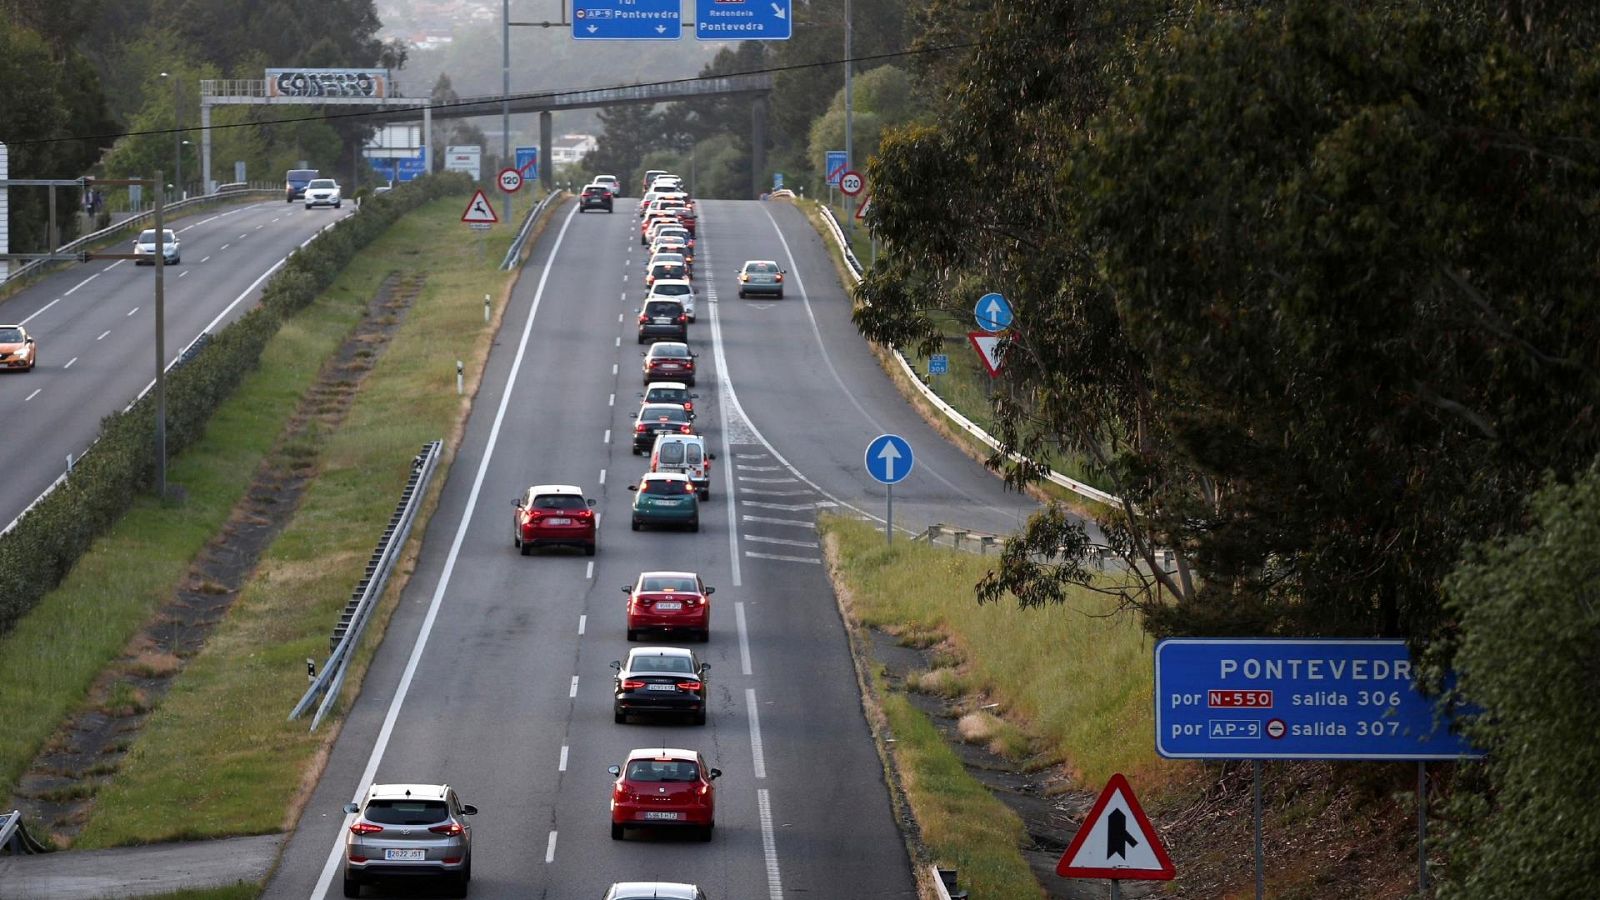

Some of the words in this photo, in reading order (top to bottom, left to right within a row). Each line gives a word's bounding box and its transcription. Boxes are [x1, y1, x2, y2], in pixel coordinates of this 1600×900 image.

[588, 10, 611, 18] AP-9
[614, 10, 679, 19] Pontevedra
[709, 9, 754, 17] Redondela
[699, 22, 764, 31] Pontevedra
[502, 176, 519, 185] 120
[844, 179, 859, 188] 120
[1219, 658, 1412, 680] PONTEVEDR
[1171, 691, 1202, 709] por
[1209, 692, 1271, 706] N-550
[1291, 691, 1348, 706] salida
[1357, 691, 1401, 706] 306
[1171, 722, 1203, 739] por
[1211, 723, 1258, 736] AP-9
[1291, 721, 1347, 736] salida
[1356, 721, 1400, 736] 307
[391, 850, 408, 858] 2622
